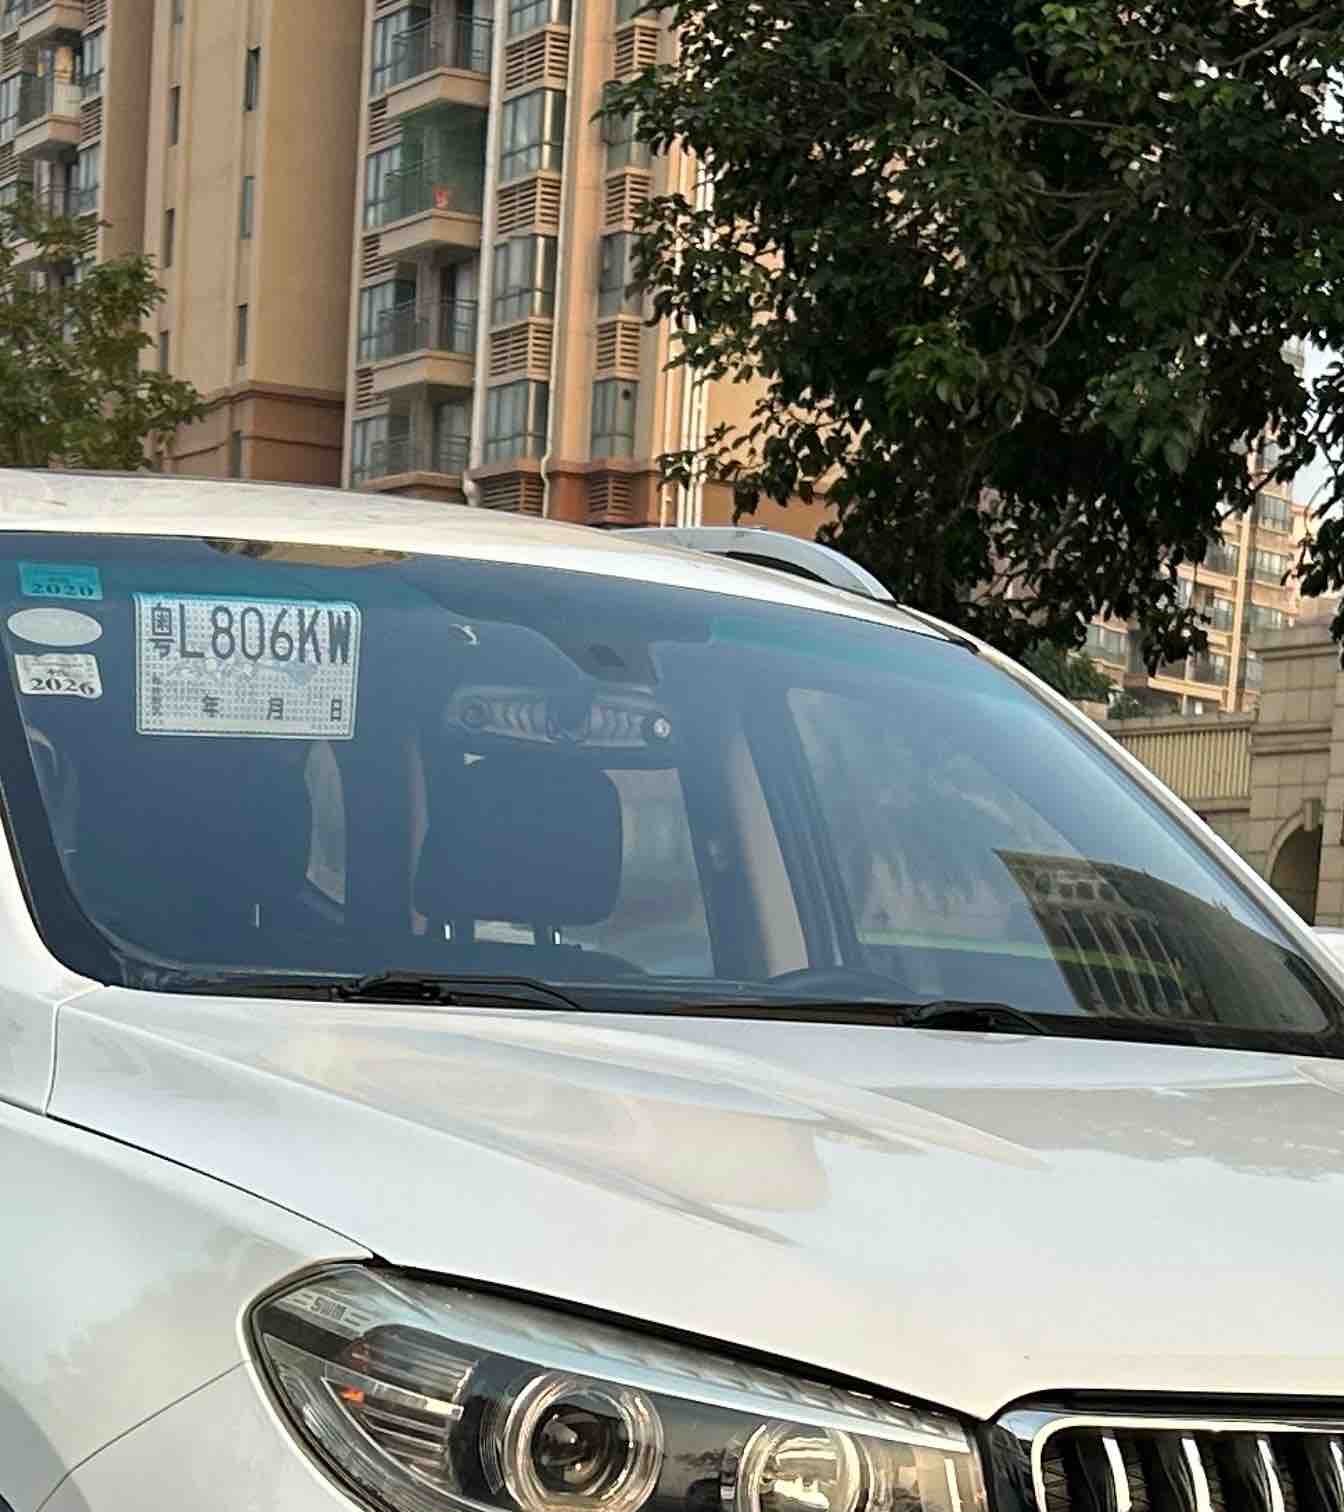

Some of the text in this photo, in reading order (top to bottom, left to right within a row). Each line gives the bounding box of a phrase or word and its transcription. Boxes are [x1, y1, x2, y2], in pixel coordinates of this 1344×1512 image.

[31, 582, 94, 597] 2020
[147, 602, 352, 665] 粤L806KW
[31, 678, 95, 695] 2026
[201, 695, 343, 722] 年 月 日
[310, 1297, 348, 1321] SWM
